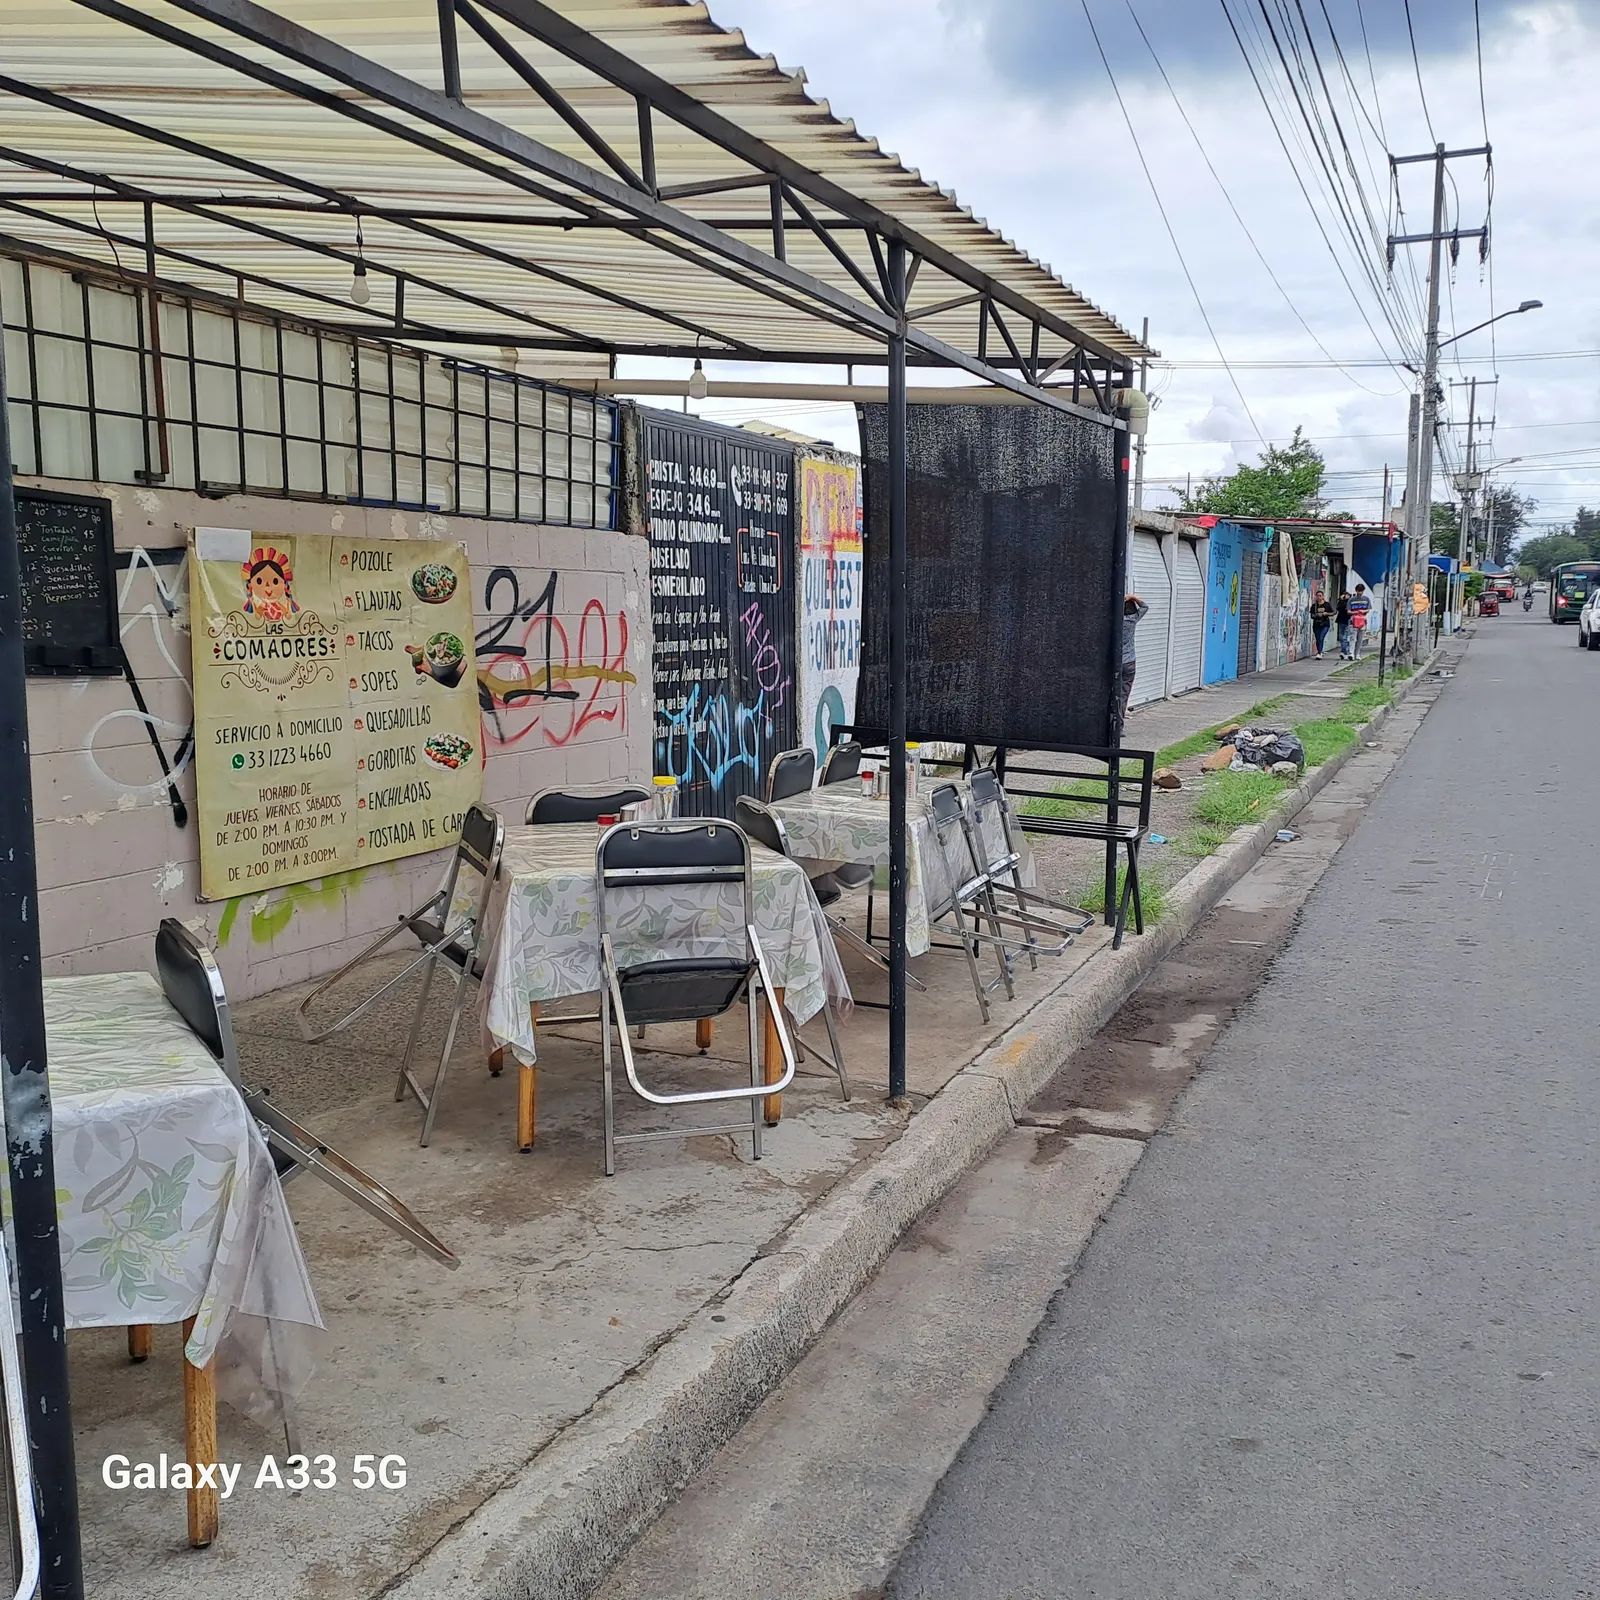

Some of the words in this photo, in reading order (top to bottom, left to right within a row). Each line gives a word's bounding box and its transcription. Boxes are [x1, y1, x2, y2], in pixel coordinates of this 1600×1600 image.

[650, 459, 686, 484] CRISTAL
[650, 488, 683, 513] ESPEJO
[650, 516, 676, 541] VIDRIO
[678, 519, 719, 543] CILINDRADO
[351, 550, 393, 572] POZOLE
[651, 547, 690, 570] BISELADO
[652, 575, 706, 597] ESMERILADO
[805, 558, 853, 616] QUIERES
[355, 590, 402, 611] FLAUTAS
[265, 623, 284, 635] LAS
[358, 631, 394, 651] TACOS
[223, 637, 328, 660] COMADRES
[361, 669, 399, 693] SOPES
[215, 724, 271, 745] SERVICIO
[276, 722, 284, 738] A
[290, 716, 343, 737] DOMICILIO
[366, 704, 431, 733] QUESADILLAS
[248, 750, 265, 769] 33
[269, 747, 296, 767] 1223
[300, 742, 332, 762] 4660
[367, 745, 416, 772] GORDITAS
[259, 784, 297, 802] HORARIO
[297, 782, 312, 795] DE
[306, 793, 342, 812] SÁBADOS
[368, 780, 432, 811] ENCHILADAS
[216, 832, 229, 846] DE
[234, 826, 257, 843] 2:00
[284, 820, 291, 833] A
[295, 816, 318, 832] 10:30
[340, 812, 348, 824] Y
[368, 821, 416, 849] TOSTADA
[422, 818, 435, 839] DE
[442, 813, 467, 833] CAR
[262, 834, 309, 856] DOMINGOS
[228, 867, 240, 882] DE
[246, 861, 270, 878] 2:00
[292, 857, 299, 869] A
